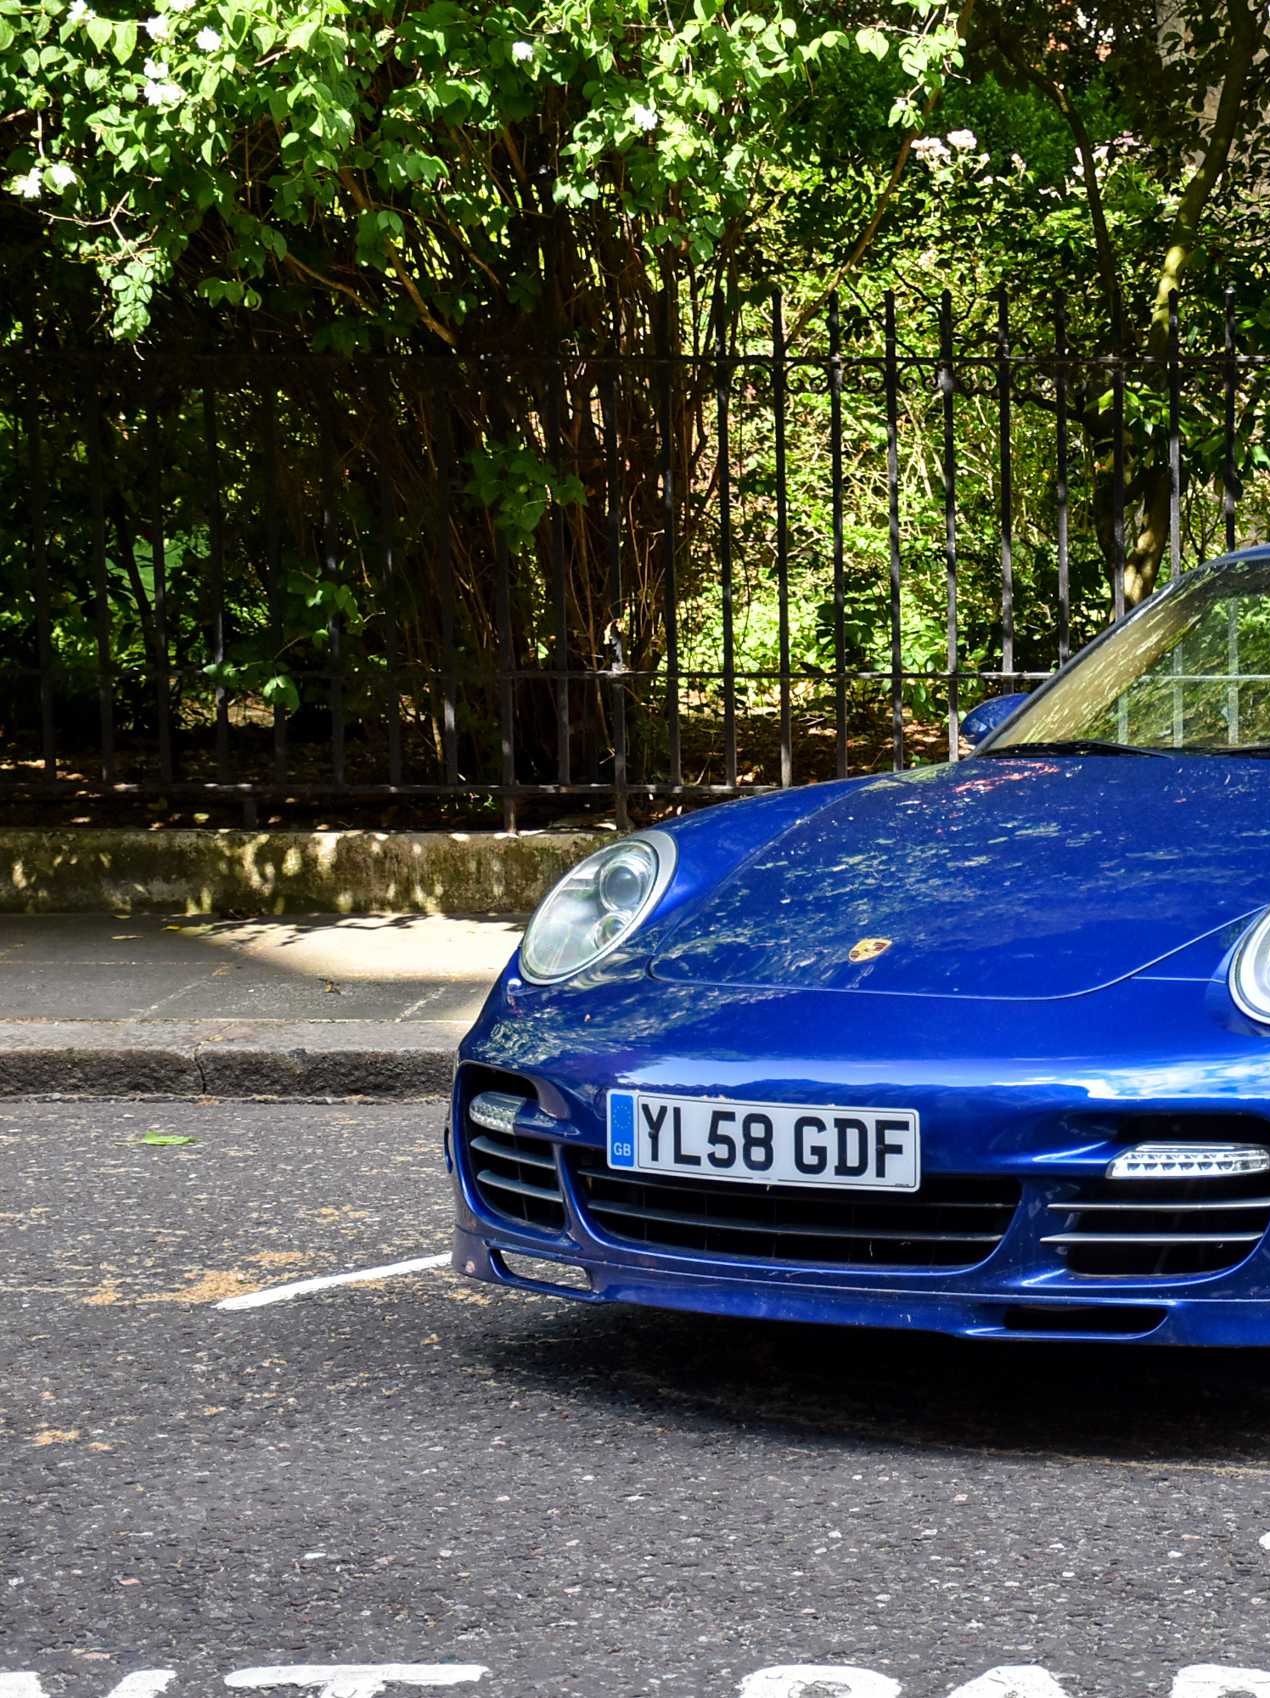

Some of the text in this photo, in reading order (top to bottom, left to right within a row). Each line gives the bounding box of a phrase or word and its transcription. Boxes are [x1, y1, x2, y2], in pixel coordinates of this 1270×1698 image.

[613, 1142, 632, 1157] GB
[641, 1103, 910, 1178] YL58 GDF
